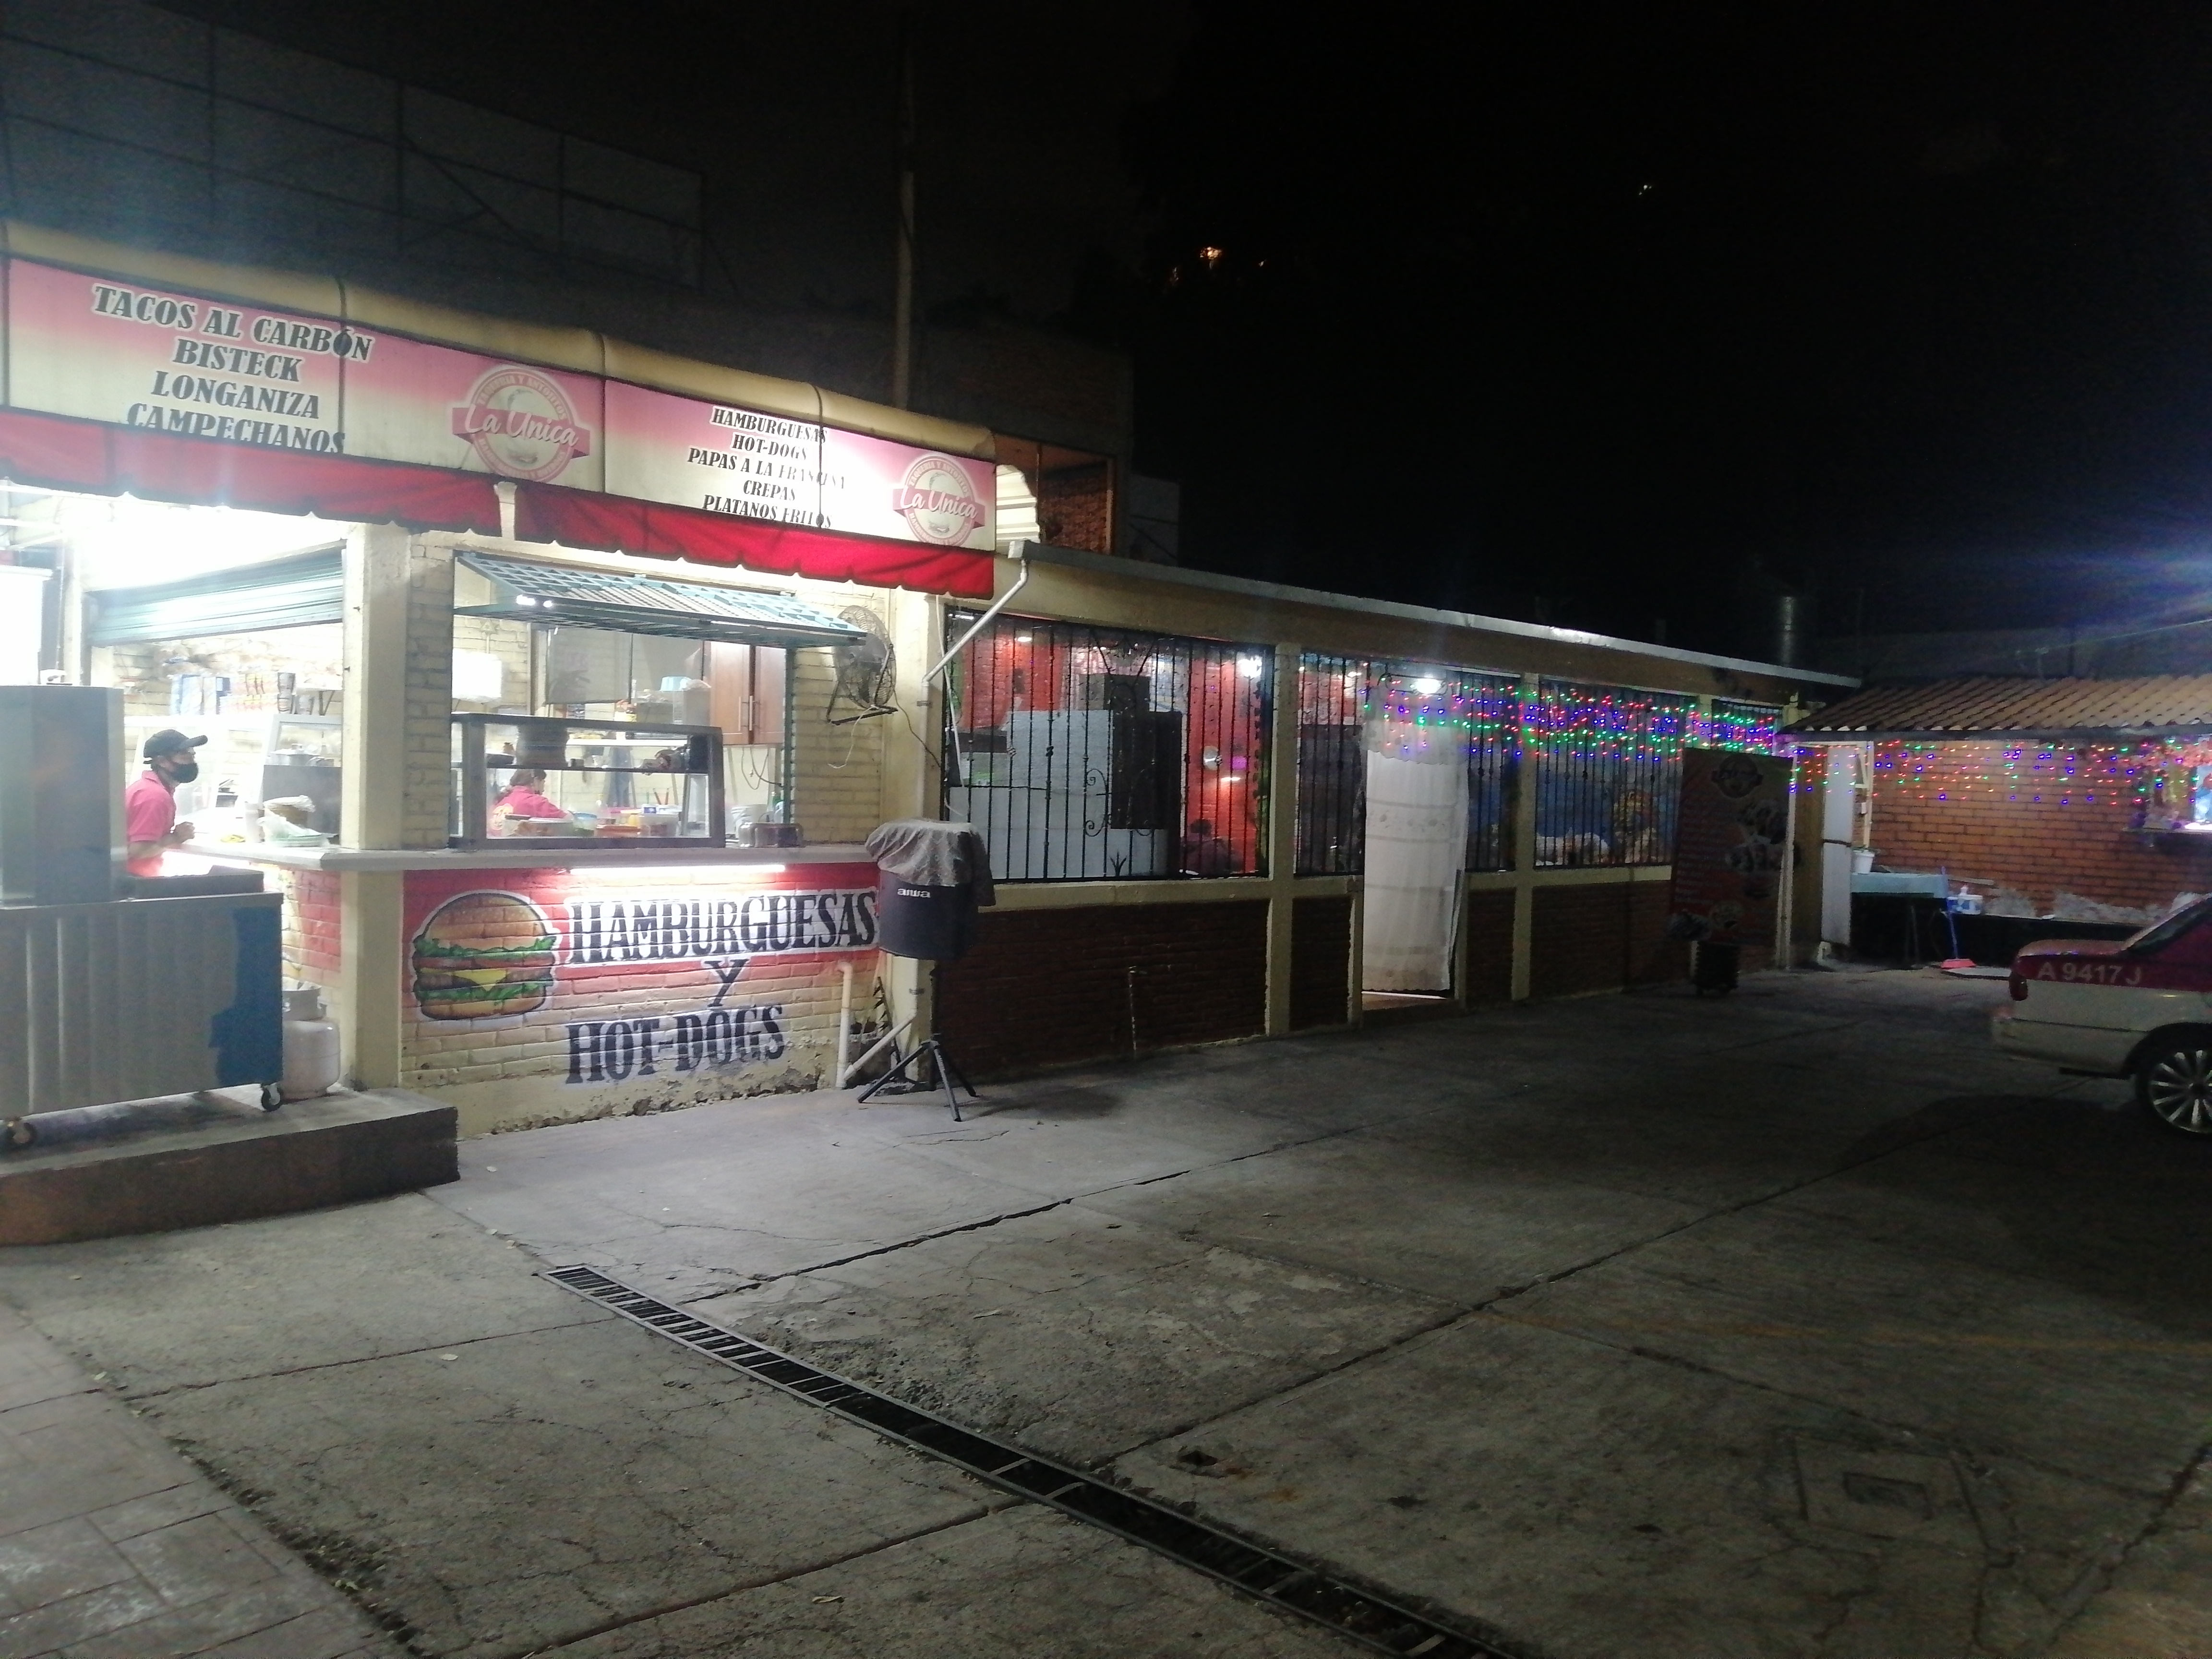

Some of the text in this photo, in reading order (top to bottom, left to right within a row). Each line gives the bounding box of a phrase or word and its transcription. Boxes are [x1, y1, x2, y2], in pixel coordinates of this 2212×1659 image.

[95, 286, 196, 329] TACOS
[202, 309, 241, 338] AL
[173, 338, 303, 382] BISTECK
[151, 371, 320, 419] LONGANIZA
[127, 403, 346, 454] CAMPECHANOS
[465, 404, 579, 447] La Unica
[711, 408, 828, 444] HAMBURGUESAS
[687, 447, 737, 470] PAPAS
[740, 458, 750, 473] A
[756, 460, 772, 477] LA
[732, 434, 808, 461] HOT-DOGS
[743, 480, 796, 501] CREPAS
[900, 484, 978, 519] La Unica
[702, 494, 832, 529] PLATANOS FRITOS
[897, 888, 931, 898] aiwa
[567, 890, 877, 965] HAMBURGUESAS
[705, 959, 750, 1007] Y
[2038, 962, 2142, 985] A 9417 J
[565, 1003, 785, 1084] HOT-DOGS
